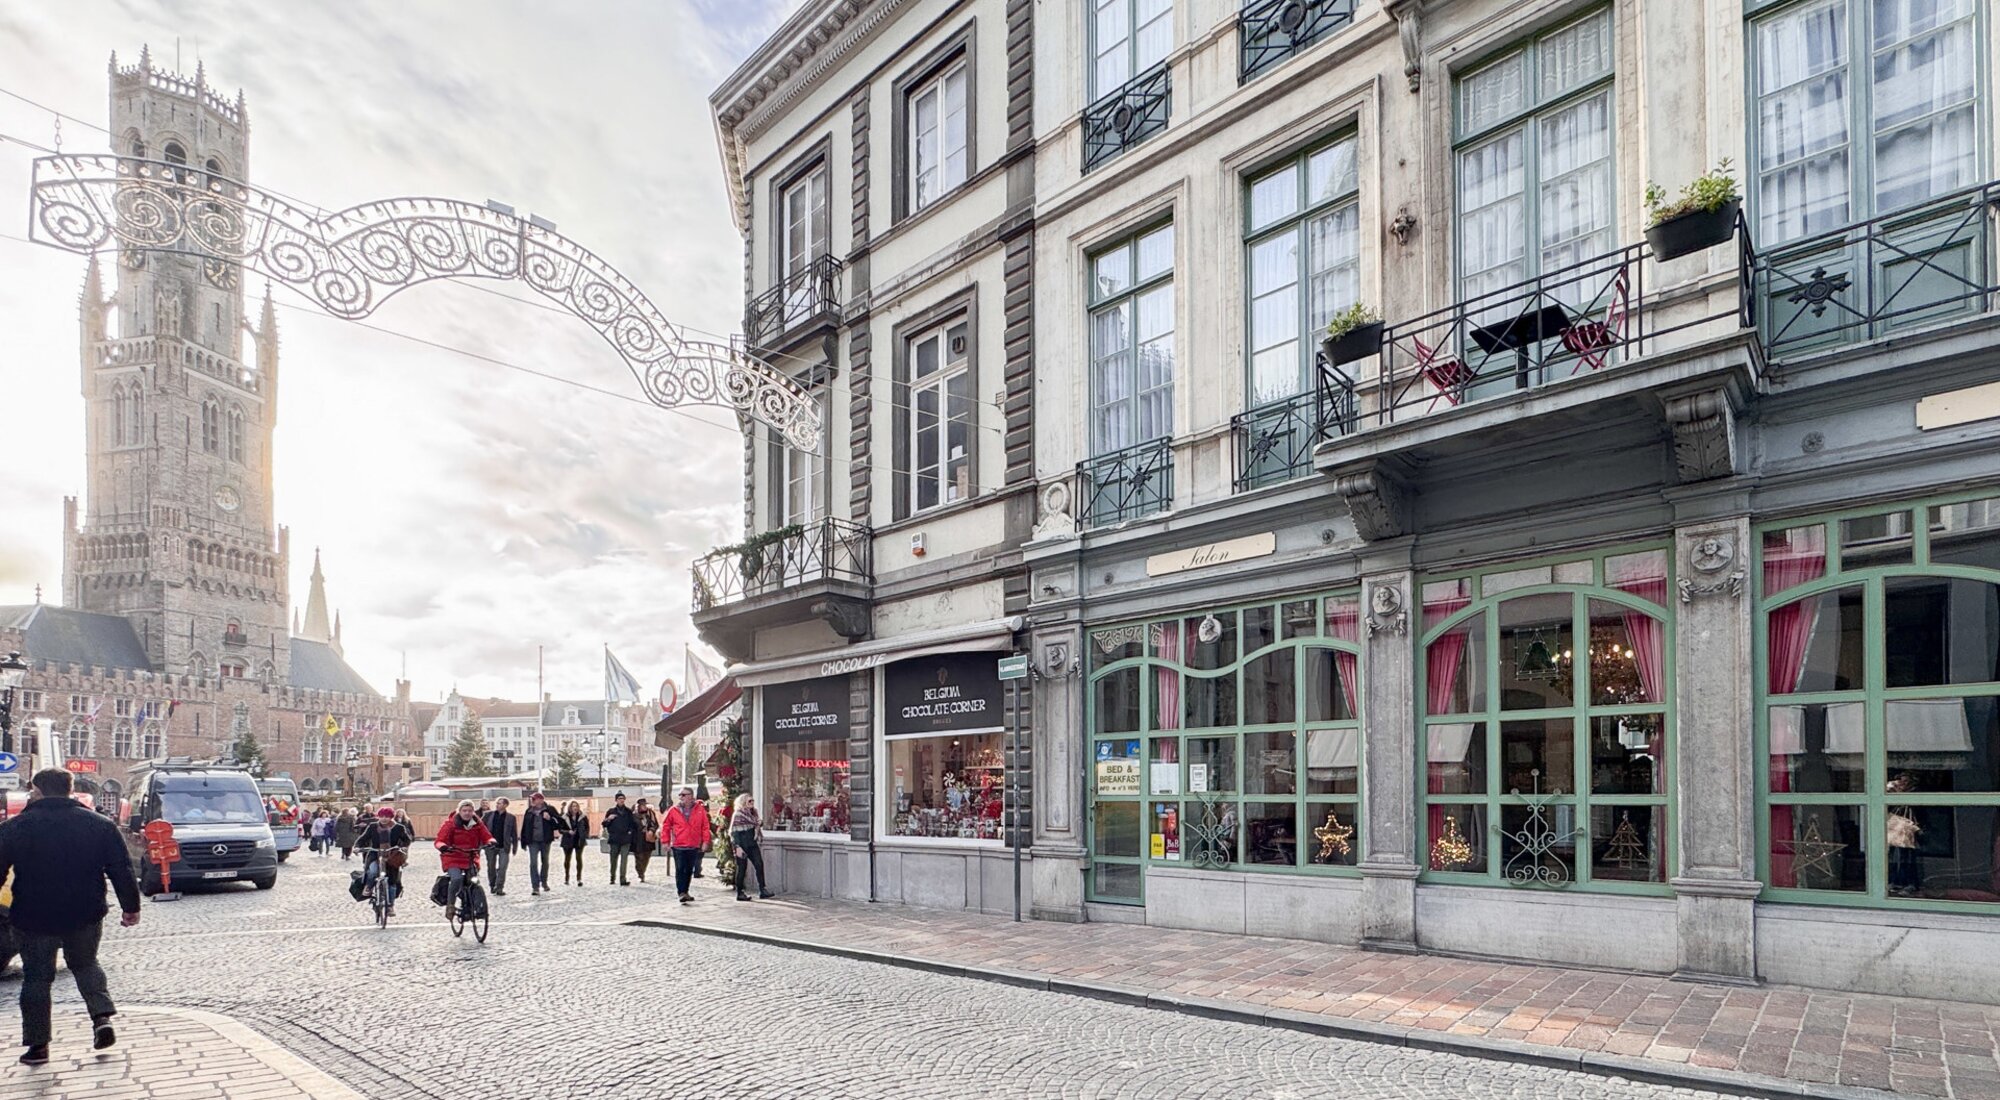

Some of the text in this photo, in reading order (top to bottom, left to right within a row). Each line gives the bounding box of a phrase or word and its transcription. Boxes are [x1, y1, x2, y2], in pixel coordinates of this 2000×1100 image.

[1181, 545, 1230, 569] Salon
[820, 653, 887, 676] CHOCOLATE
[923, 686, 960, 700] BELGIUM
[791, 702, 819, 715] BELGIUM
[901, 699, 986, 718] CHOCOLATE CORNER
[774, 714, 838, 730] CHOCOLATE CORNER
[1106, 765, 1132, 774] BED &
[1099, 775, 1140, 784] BREAKFAST
